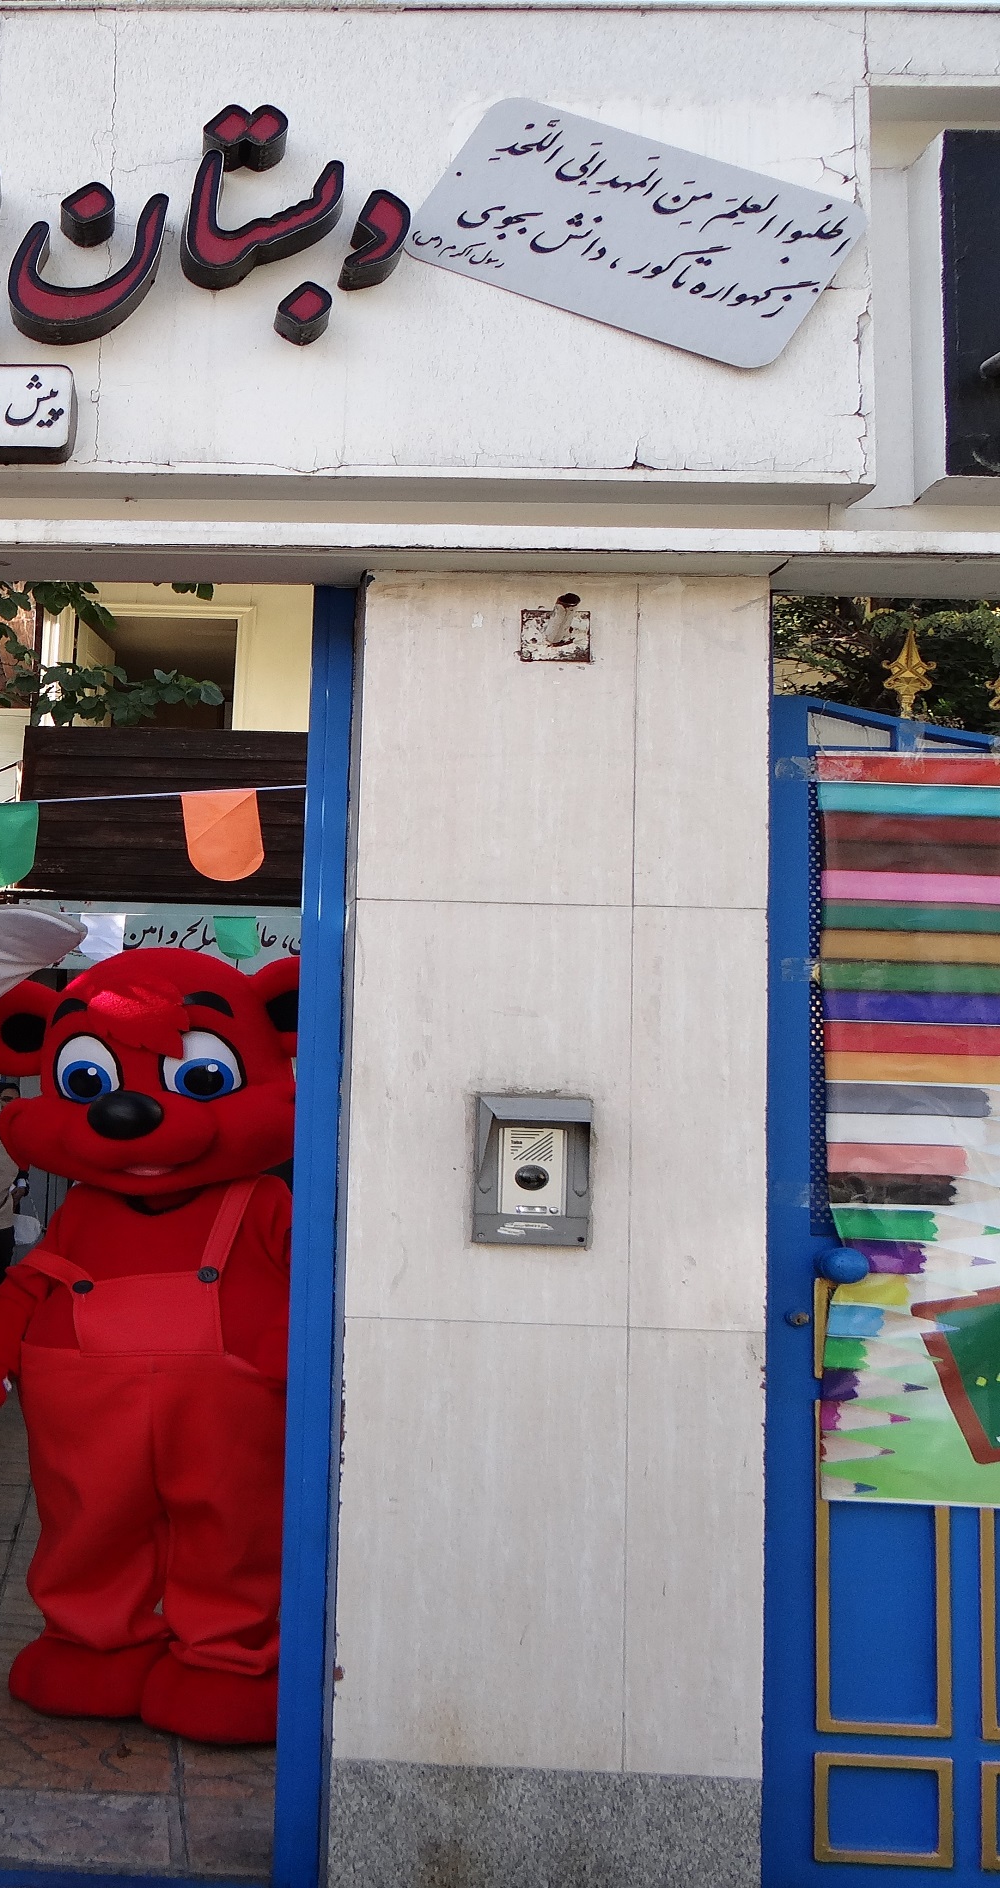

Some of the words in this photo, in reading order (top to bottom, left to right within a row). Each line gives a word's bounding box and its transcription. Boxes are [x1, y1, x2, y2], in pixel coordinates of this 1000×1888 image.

[7, 104, 411, 346] دبستان
[530, 212, 607, 262] دانش
[438, 242, 487, 257] اکرم
[468, 249, 505, 269] رسول
[672, 256, 712, 289] تا
[5, 373, 65, 428] پیش
[165, 930, 179, 945] و
